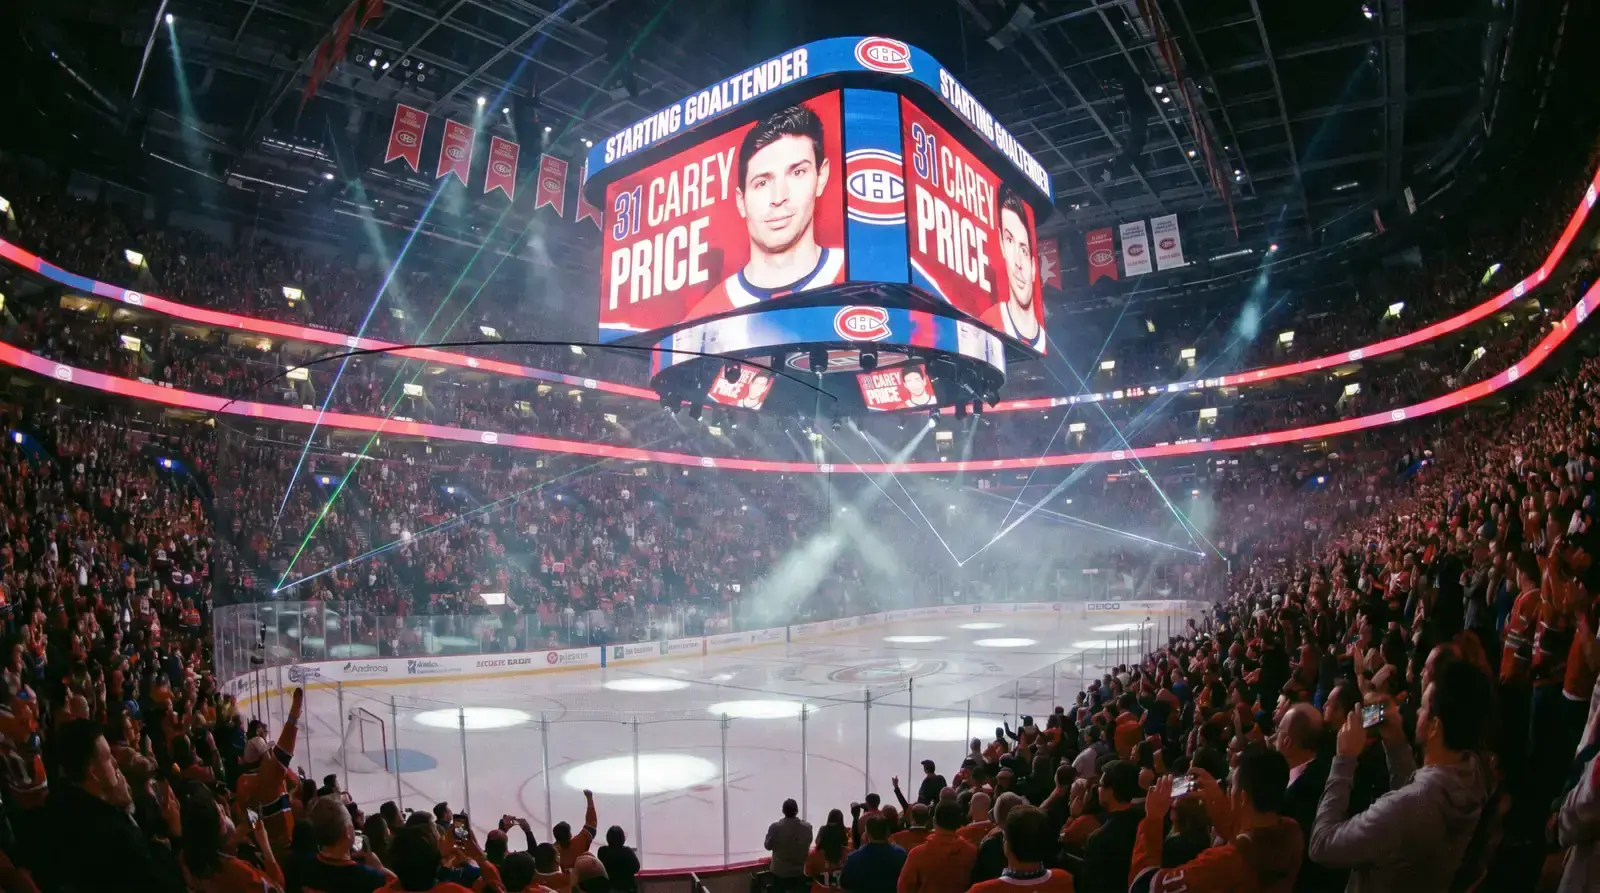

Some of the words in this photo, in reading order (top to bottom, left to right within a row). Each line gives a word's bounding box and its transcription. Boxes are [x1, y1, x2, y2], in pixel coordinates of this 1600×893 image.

[604, 103, 682, 164] STARTING
[684, 48, 808, 126] GOALTENDER
[939, 68, 995, 141] STARTING
[993, 121, 1051, 197] GOALTENDER
[613, 185, 643, 241] 31
[647, 146, 736, 227] CAREY
[911, 122, 939, 188] 31
[941, 145, 995, 229] CAREY
[609, 216, 711, 310] PRICE
[915, 184, 992, 293] PRICE
[866, 387, 902, 405] PRICE
[872, 372, 902, 388] CAREY
